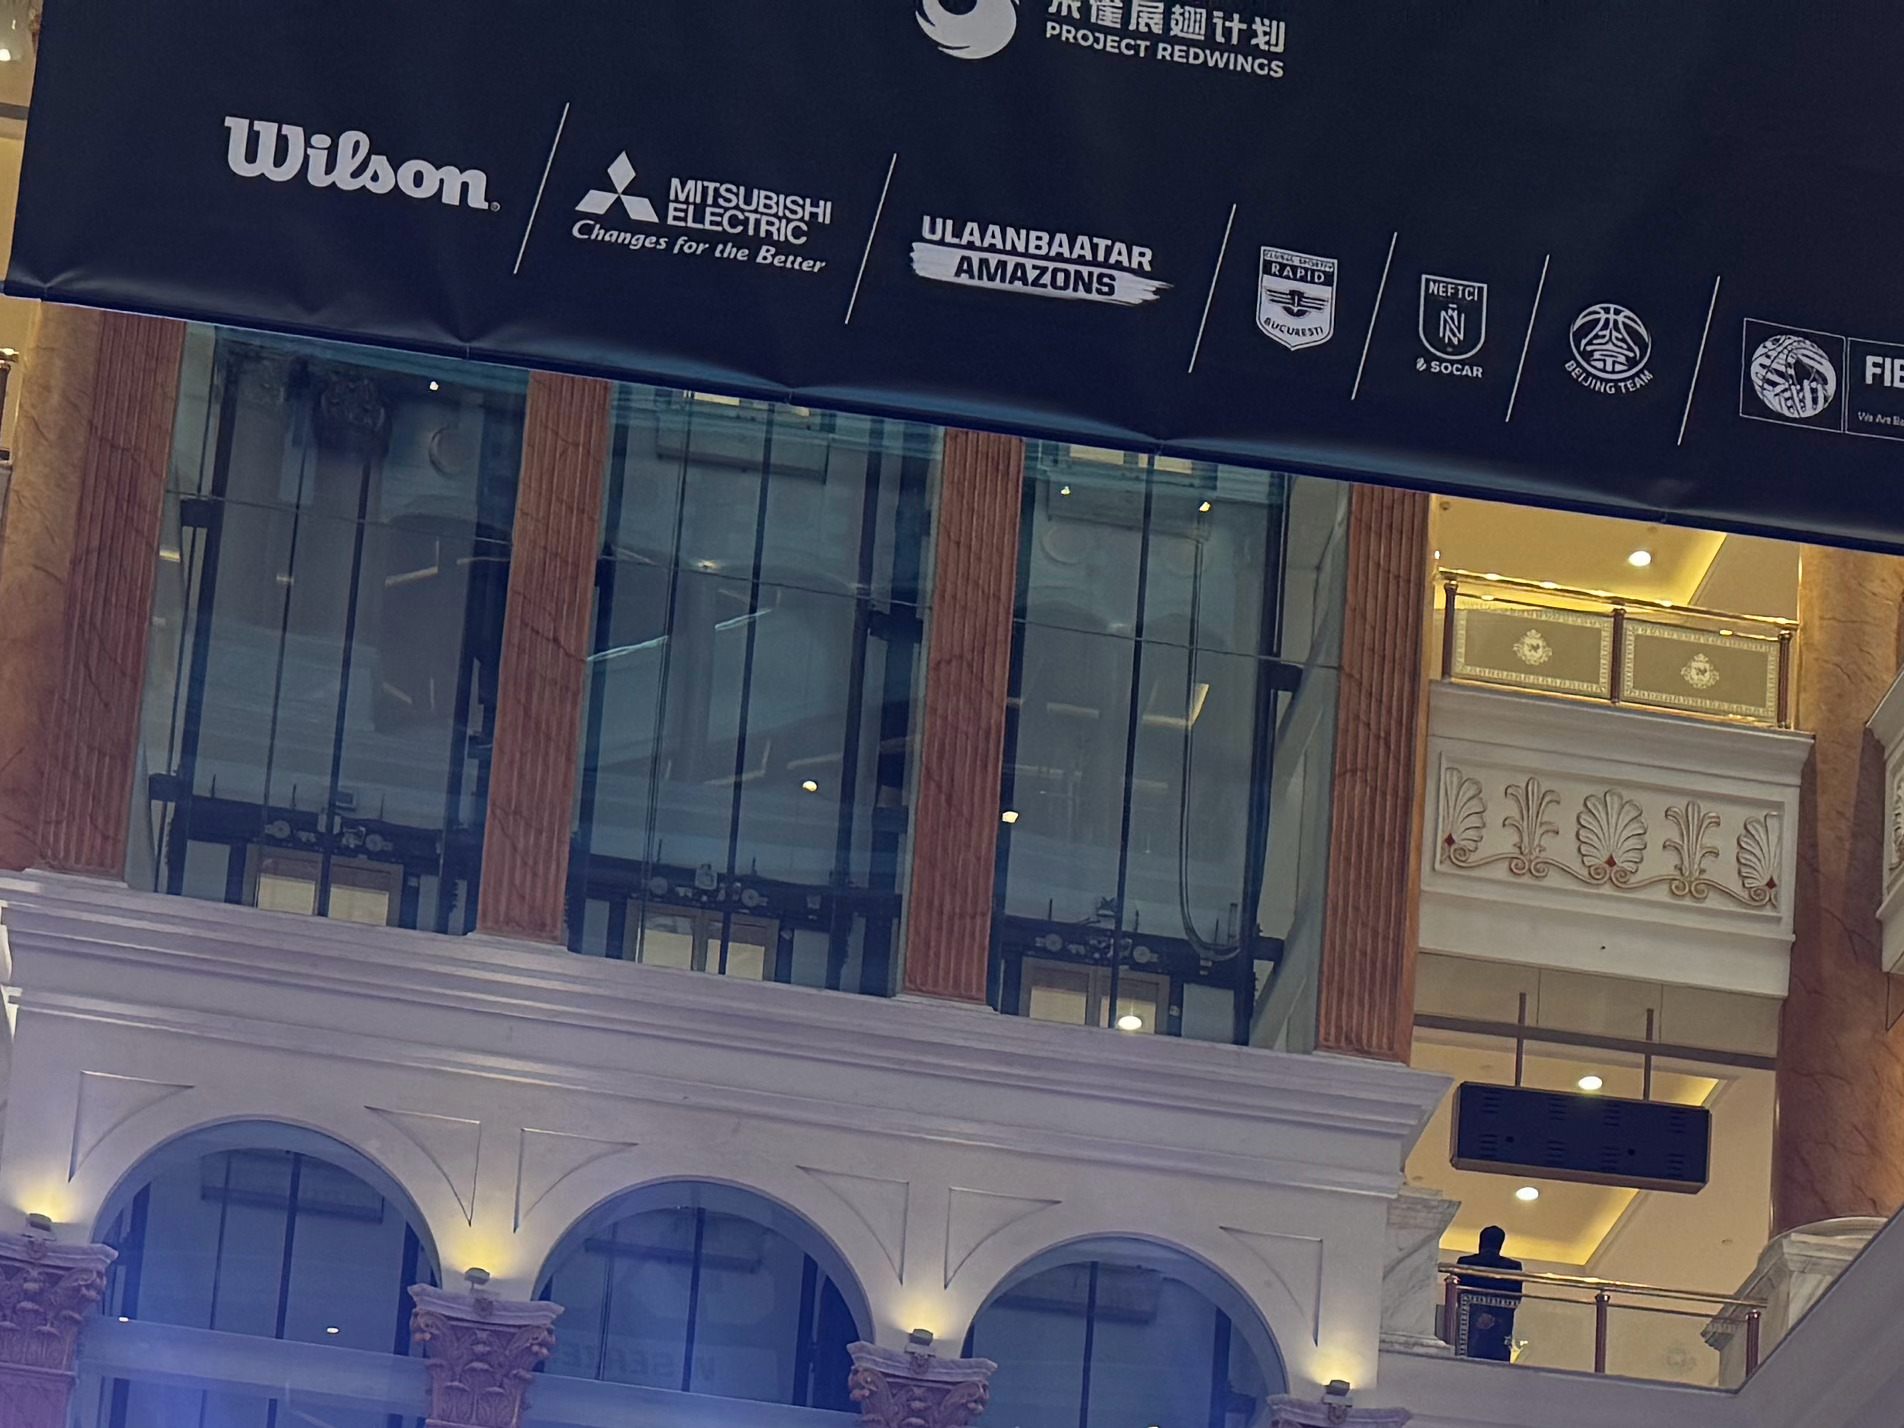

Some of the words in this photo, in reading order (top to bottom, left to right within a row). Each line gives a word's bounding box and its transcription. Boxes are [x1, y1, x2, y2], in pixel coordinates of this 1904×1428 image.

[1046, 21, 1149, 58] PROJECT
[1156, 45, 1286, 78] REDWINGS
[224, 116, 490, 210] Wilson
[669, 177, 832, 224] MITSUBISHI
[667, 202, 808, 245] ELECTRIC
[921, 215, 1154, 272] ULAANBAATAR
[572, 220, 668, 250] Changes
[673, 236, 709, 255] for
[714, 242, 749, 261] the
[755, 245, 826, 273] Better
[954, 255, 1116, 296] AMAZONS
[1271, 263, 1325, 283] RAPID
[1430, 361, 1483, 378] SOCAR
[1564, 359, 1615, 394] BEIJING
[1617, 369, 1654, 394] TEAM
